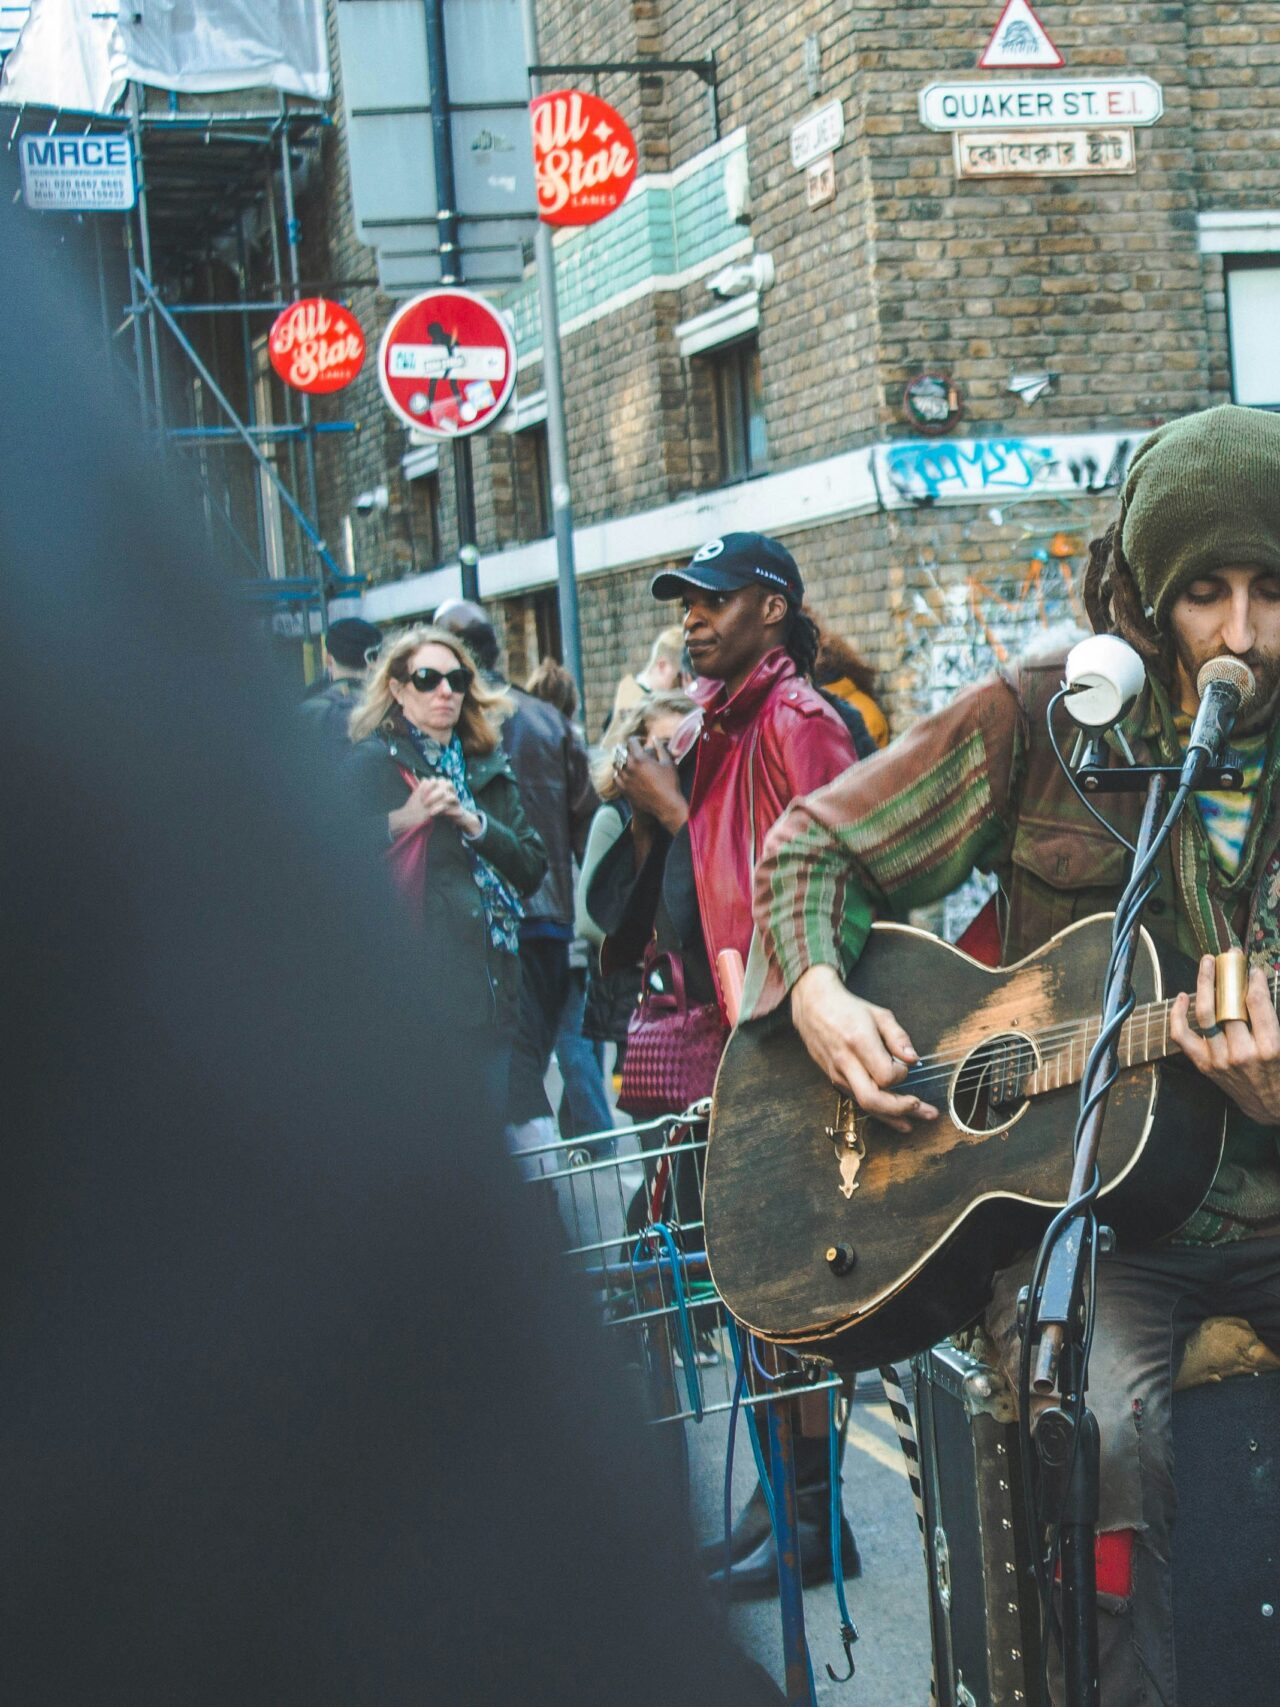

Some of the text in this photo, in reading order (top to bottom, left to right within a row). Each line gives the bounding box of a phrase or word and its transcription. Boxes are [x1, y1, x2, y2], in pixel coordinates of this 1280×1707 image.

[532, 91, 591, 154] All
[942, 93, 1054, 118] QUAKER
[1063, 91, 1099, 116] ST.
[27, 142, 127, 166] MACE
[535, 140, 635, 215] Star
[273, 298, 332, 354] All
[289, 333, 364, 386] Star
